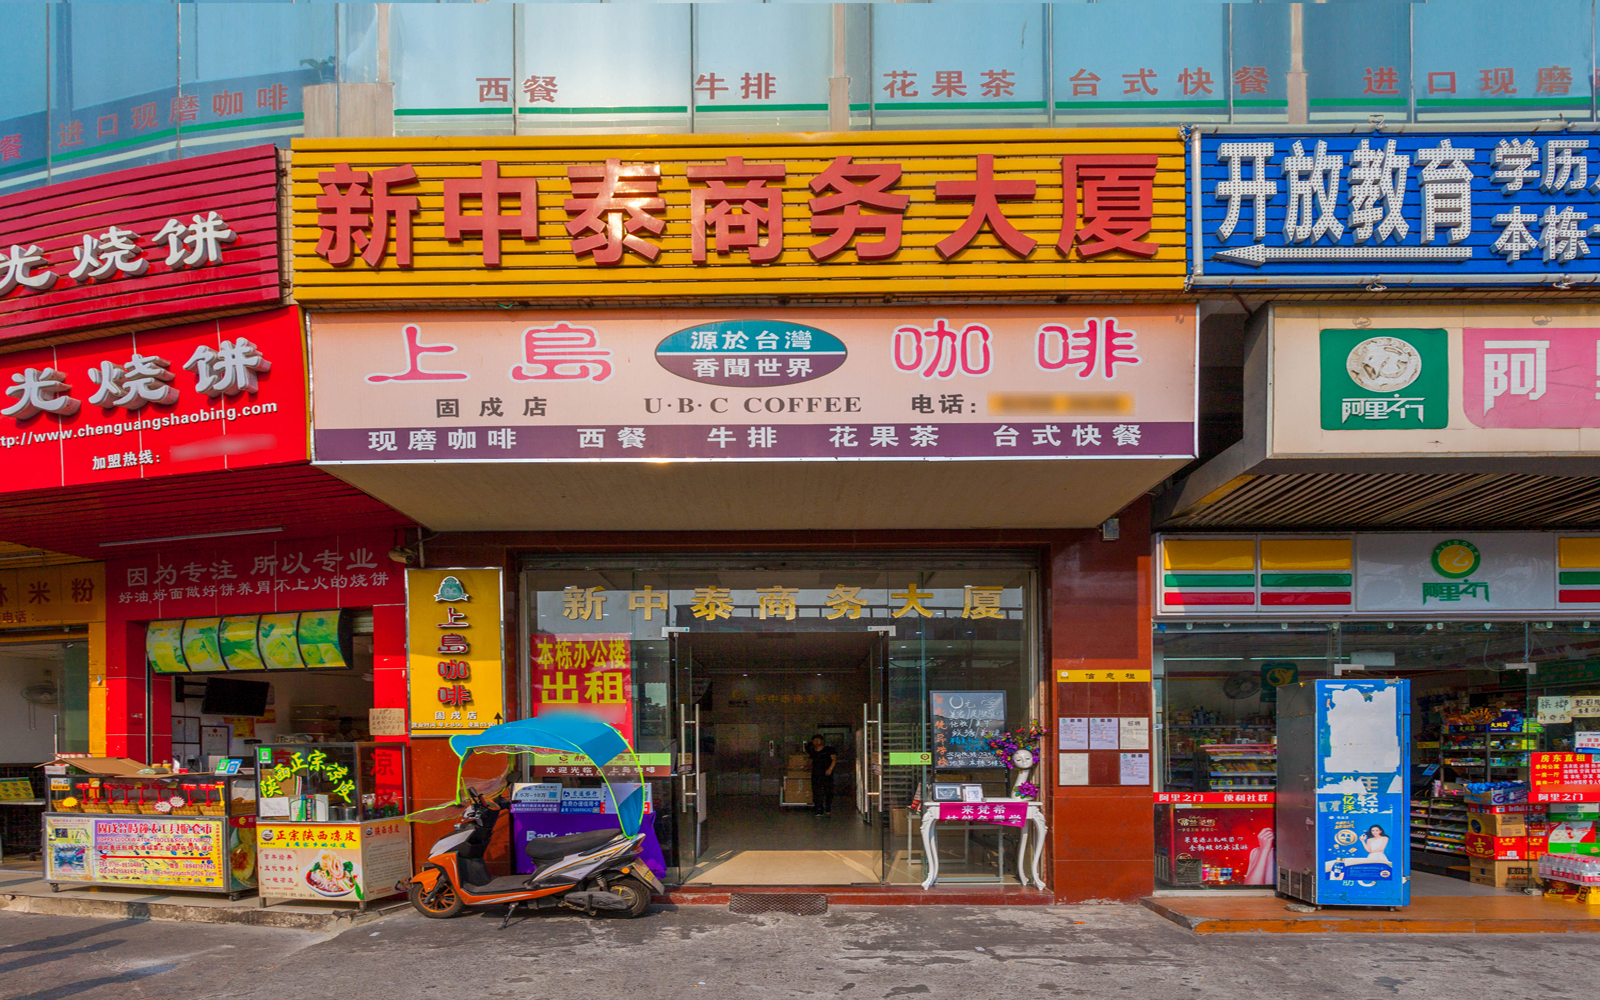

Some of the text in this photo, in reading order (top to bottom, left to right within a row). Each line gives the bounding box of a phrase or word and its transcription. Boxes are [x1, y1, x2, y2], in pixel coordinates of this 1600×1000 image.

[476, 65, 1600, 103] 西餐 牛排 花果茶 台式快餐 进口现磨
[1490, 138, 1600, 196] 学历
[1215, 138, 1476, 245] 开放教育
[315, 154, 1159, 267] 新中泰商务大厦
[1490, 205, 1600, 264] 本栋
[690, 330, 813, 351] 源於台灣
[891, 317, 1142, 380] 咖啡
[692, 358, 813, 378] 香聞世界
[743, 397, 862, 414] COFFEE
[0, 402, 278, 447] tp://www.chenguangshaobing.com
[368, 425, 1142, 451] 现磨咖啡 西餐 牛排 花果茶 台式快餐
[127, 548, 378, 587] 因为专注 所以专业
[562, 584, 1005, 621] 新中泰商务大厦
[537, 637, 627, 670] 本栋办公楼
[541, 671, 627, 704] 出租
[1540, 754, 1586, 763] 房东直租
[1158, 793, 1204, 802] 阿里之门
[1538, 793, 1583, 801] 阿里之门
[1473, 837, 1486, 853] 吉
